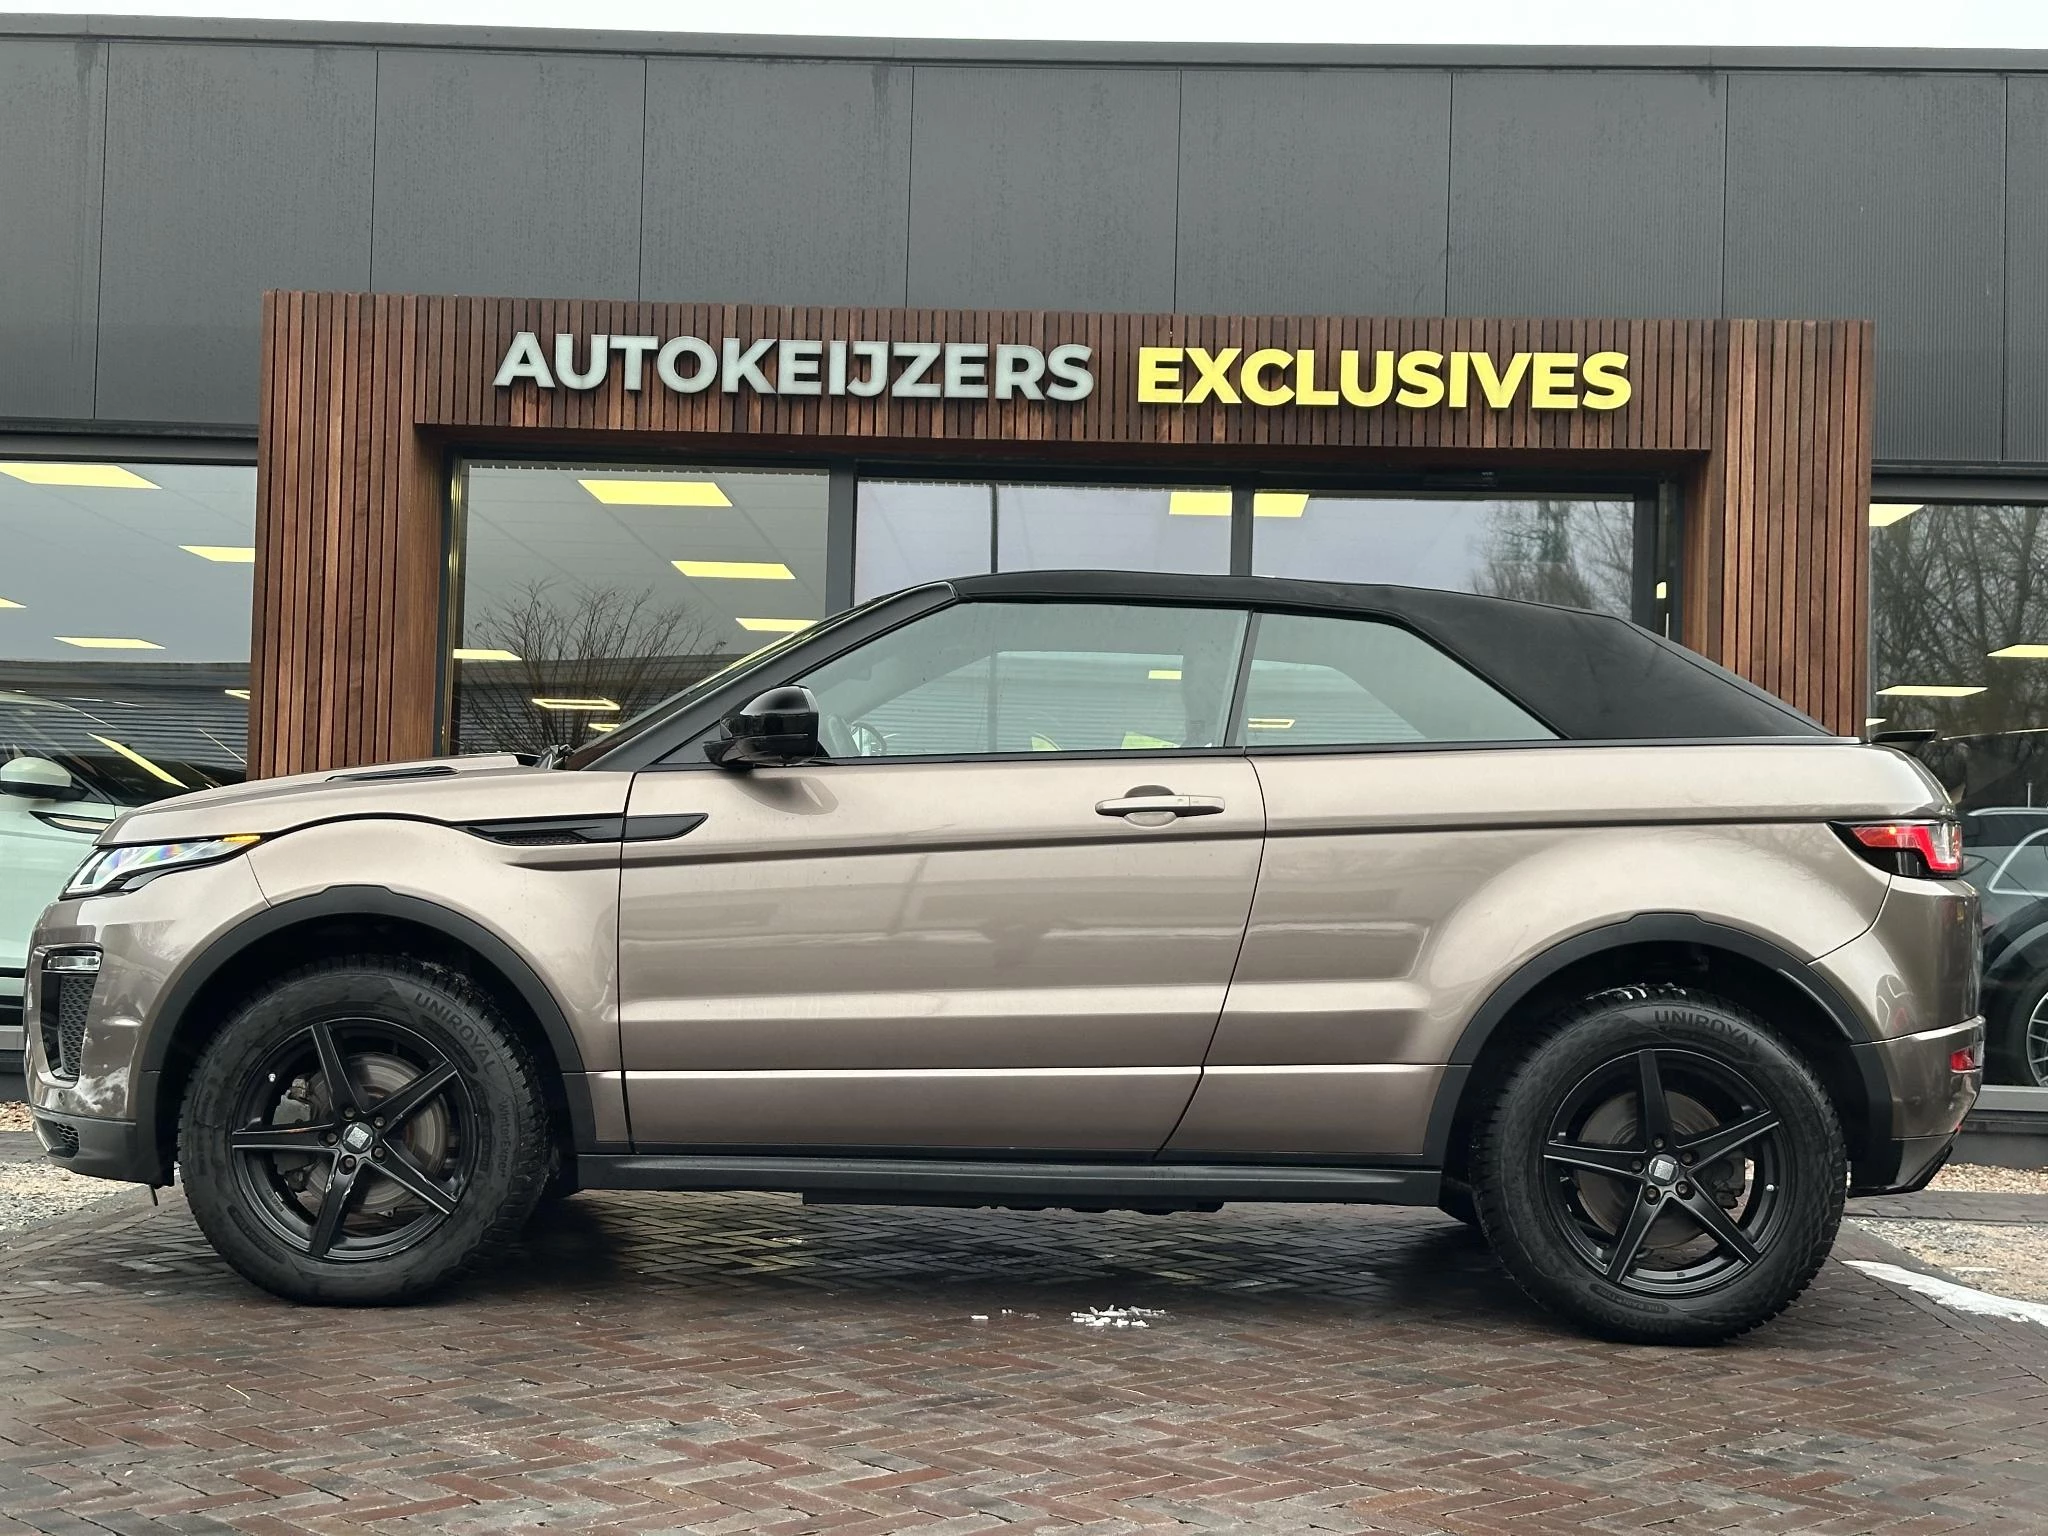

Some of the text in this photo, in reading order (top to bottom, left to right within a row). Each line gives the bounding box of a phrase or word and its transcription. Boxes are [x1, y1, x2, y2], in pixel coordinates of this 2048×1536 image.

[492, 331, 1632, 410] AUTOKEIJZERS EXCLUSIVES
[415, 991, 496, 1075] UNIROYAL
